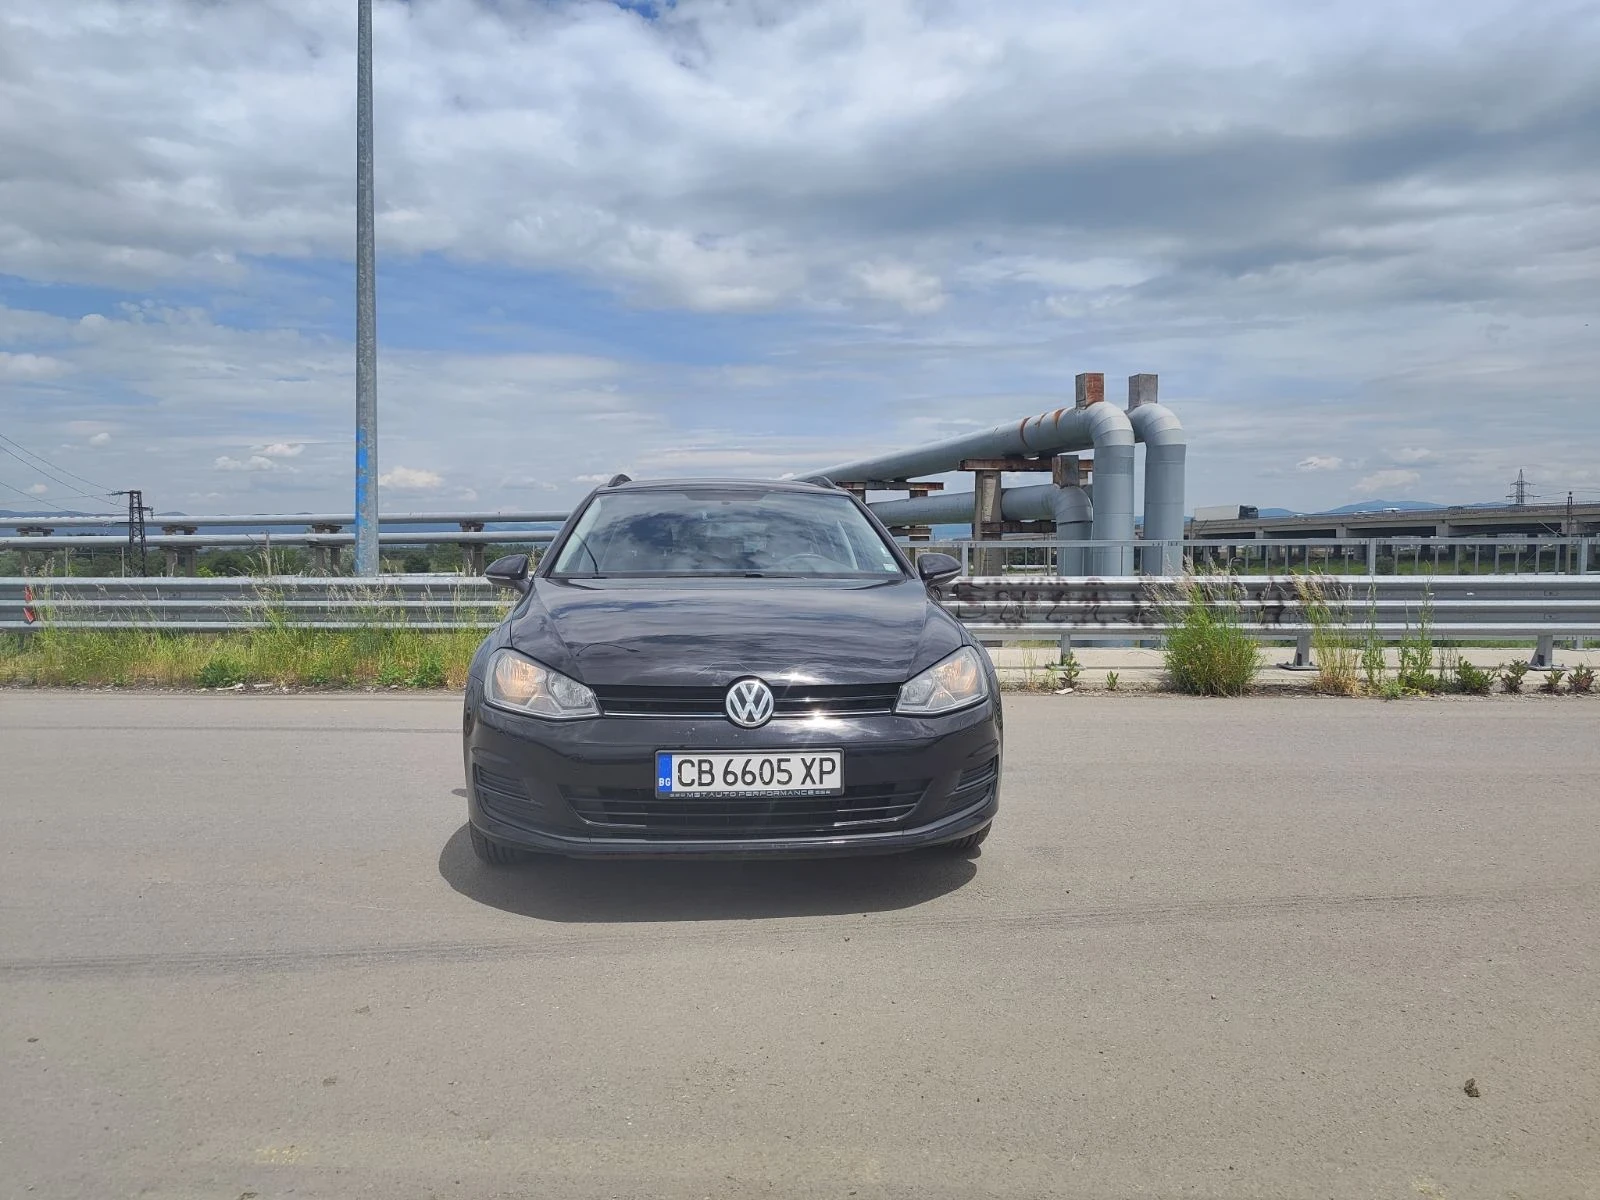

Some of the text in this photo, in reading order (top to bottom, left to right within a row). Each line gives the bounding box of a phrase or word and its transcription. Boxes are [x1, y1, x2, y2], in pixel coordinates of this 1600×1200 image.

[728, 681, 772, 724] VW
[658, 777, 671, 787] BG
[677, 757, 837, 787] CB 6605 XP
[738, 789, 814, 797] PERFORMANCE
